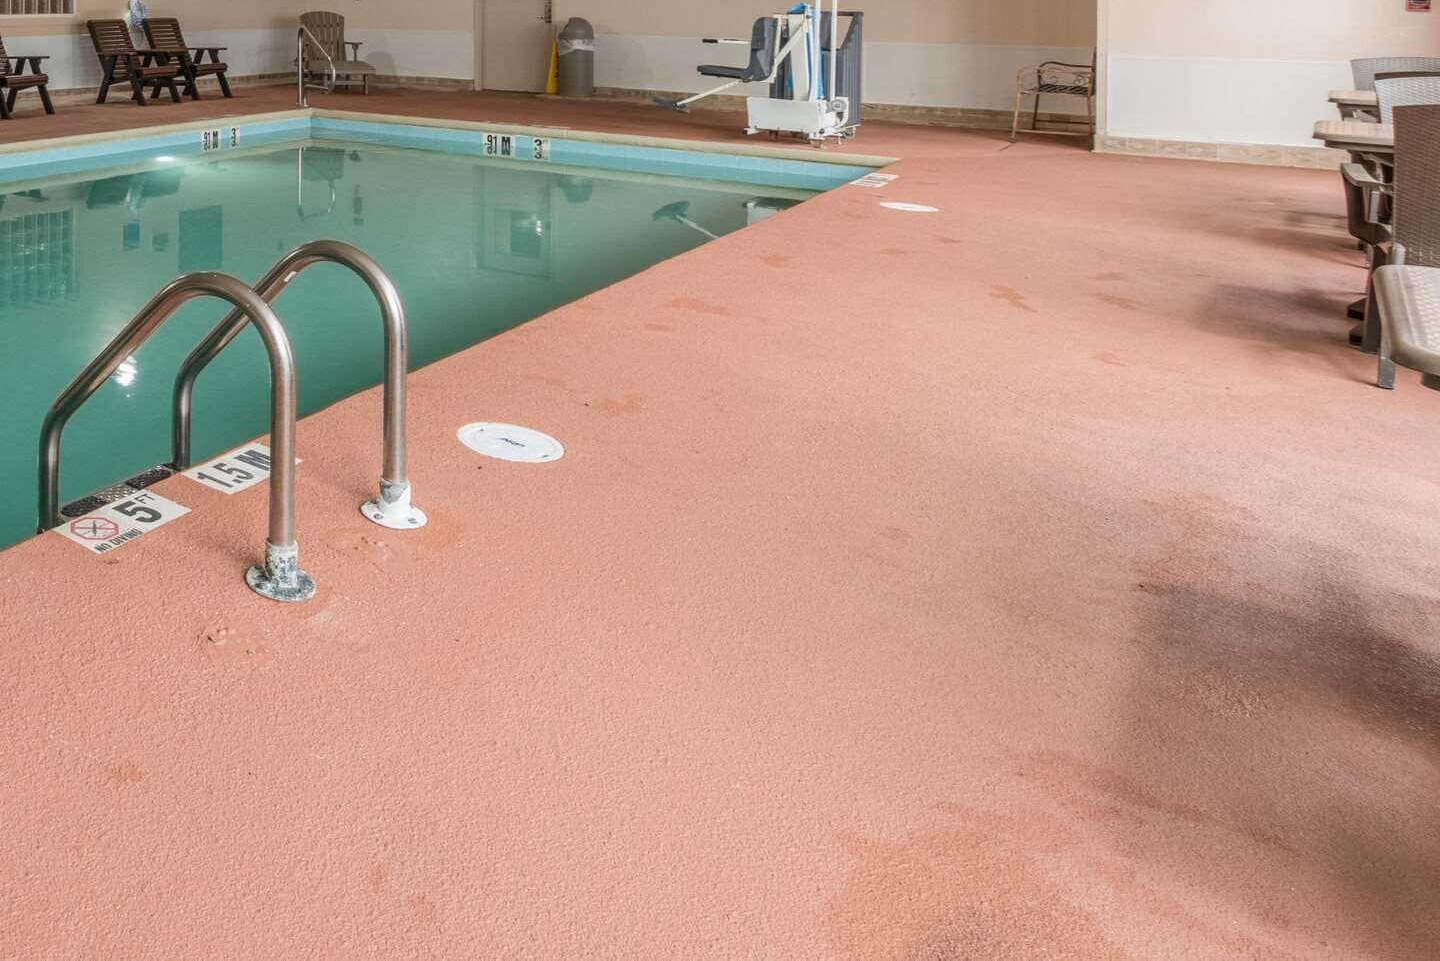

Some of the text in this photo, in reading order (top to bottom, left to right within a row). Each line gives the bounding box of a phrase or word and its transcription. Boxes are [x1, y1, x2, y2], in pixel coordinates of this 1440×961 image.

[197, 462, 255, 488] 1.5
[111, 493, 163, 524] 5 FT
[95, 528, 143, 553] NO DIVING
